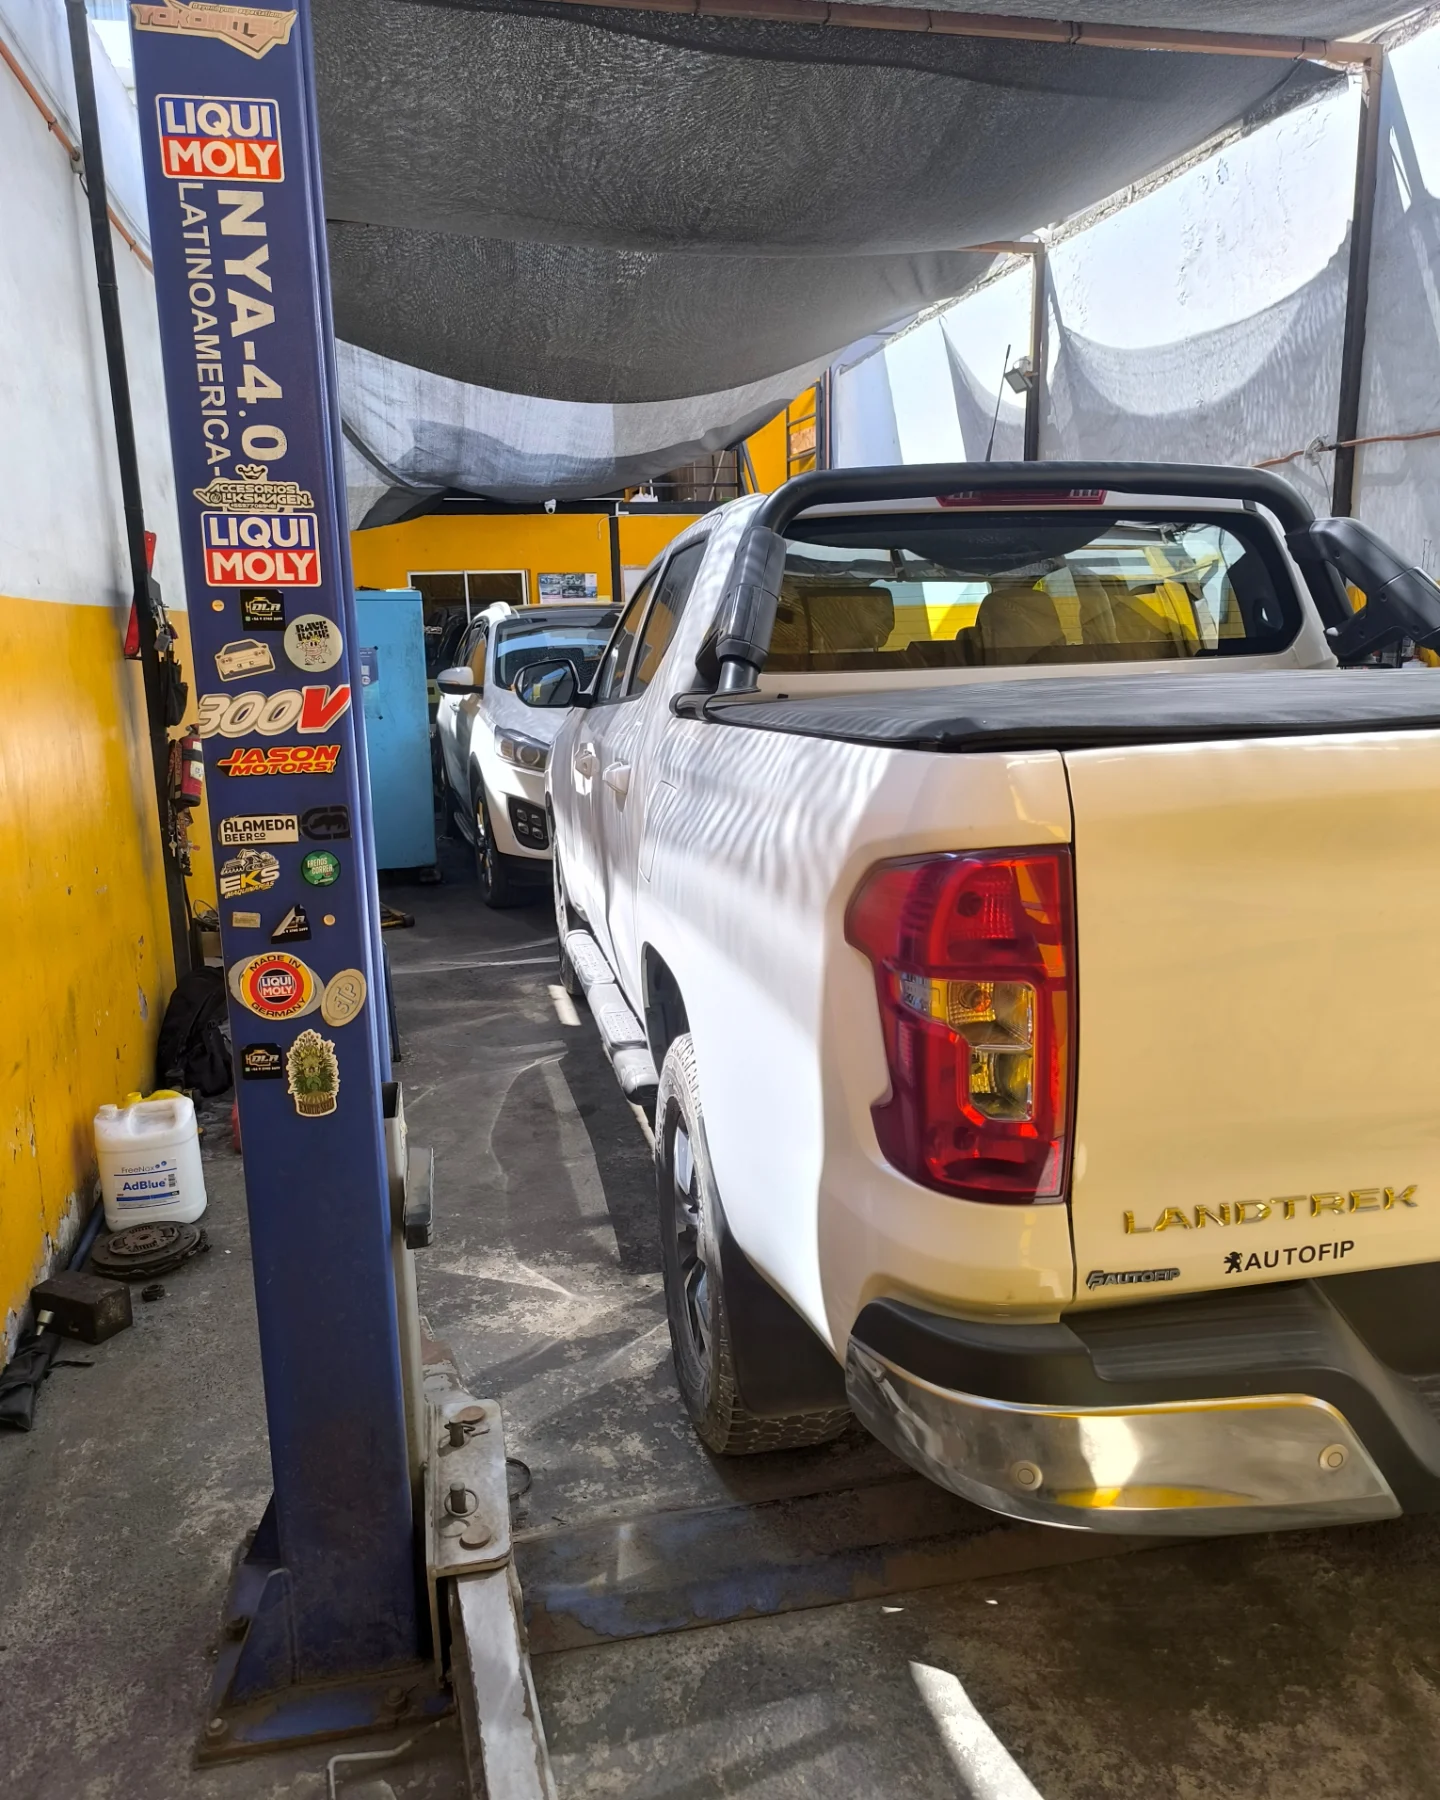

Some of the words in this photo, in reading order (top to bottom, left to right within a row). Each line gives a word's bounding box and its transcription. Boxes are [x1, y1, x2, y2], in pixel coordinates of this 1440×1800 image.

[164, 101, 272, 138] LIQUI
[168, 140, 277, 175] MOLY
[210, 483, 296, 494] ACCESORIOS
[209, 517, 310, 548] LIQUI
[213, 552, 314, 581] MOLY
[199, 684, 351, 738] 300V
[218, 745, 341, 765] JASON
[229, 762, 329, 776] MOTORS
[223, 819, 296, 832] ALAMEDA
[225, 833, 253, 842] BEER
[221, 865, 280, 895] EKS
[250, 955, 285, 972] MADE
[288, 957, 301, 969] IN
[262, 976, 293, 987] LIQUI
[263, 986, 293, 997] MOLY
[251, 997, 306, 1017] GERMANY
[123, 1179, 166, 1191] AdBlue
[1122, 1184, 1419, 1235] LANDTREK
[1244, 1240, 1355, 1271] AUTOFIP
